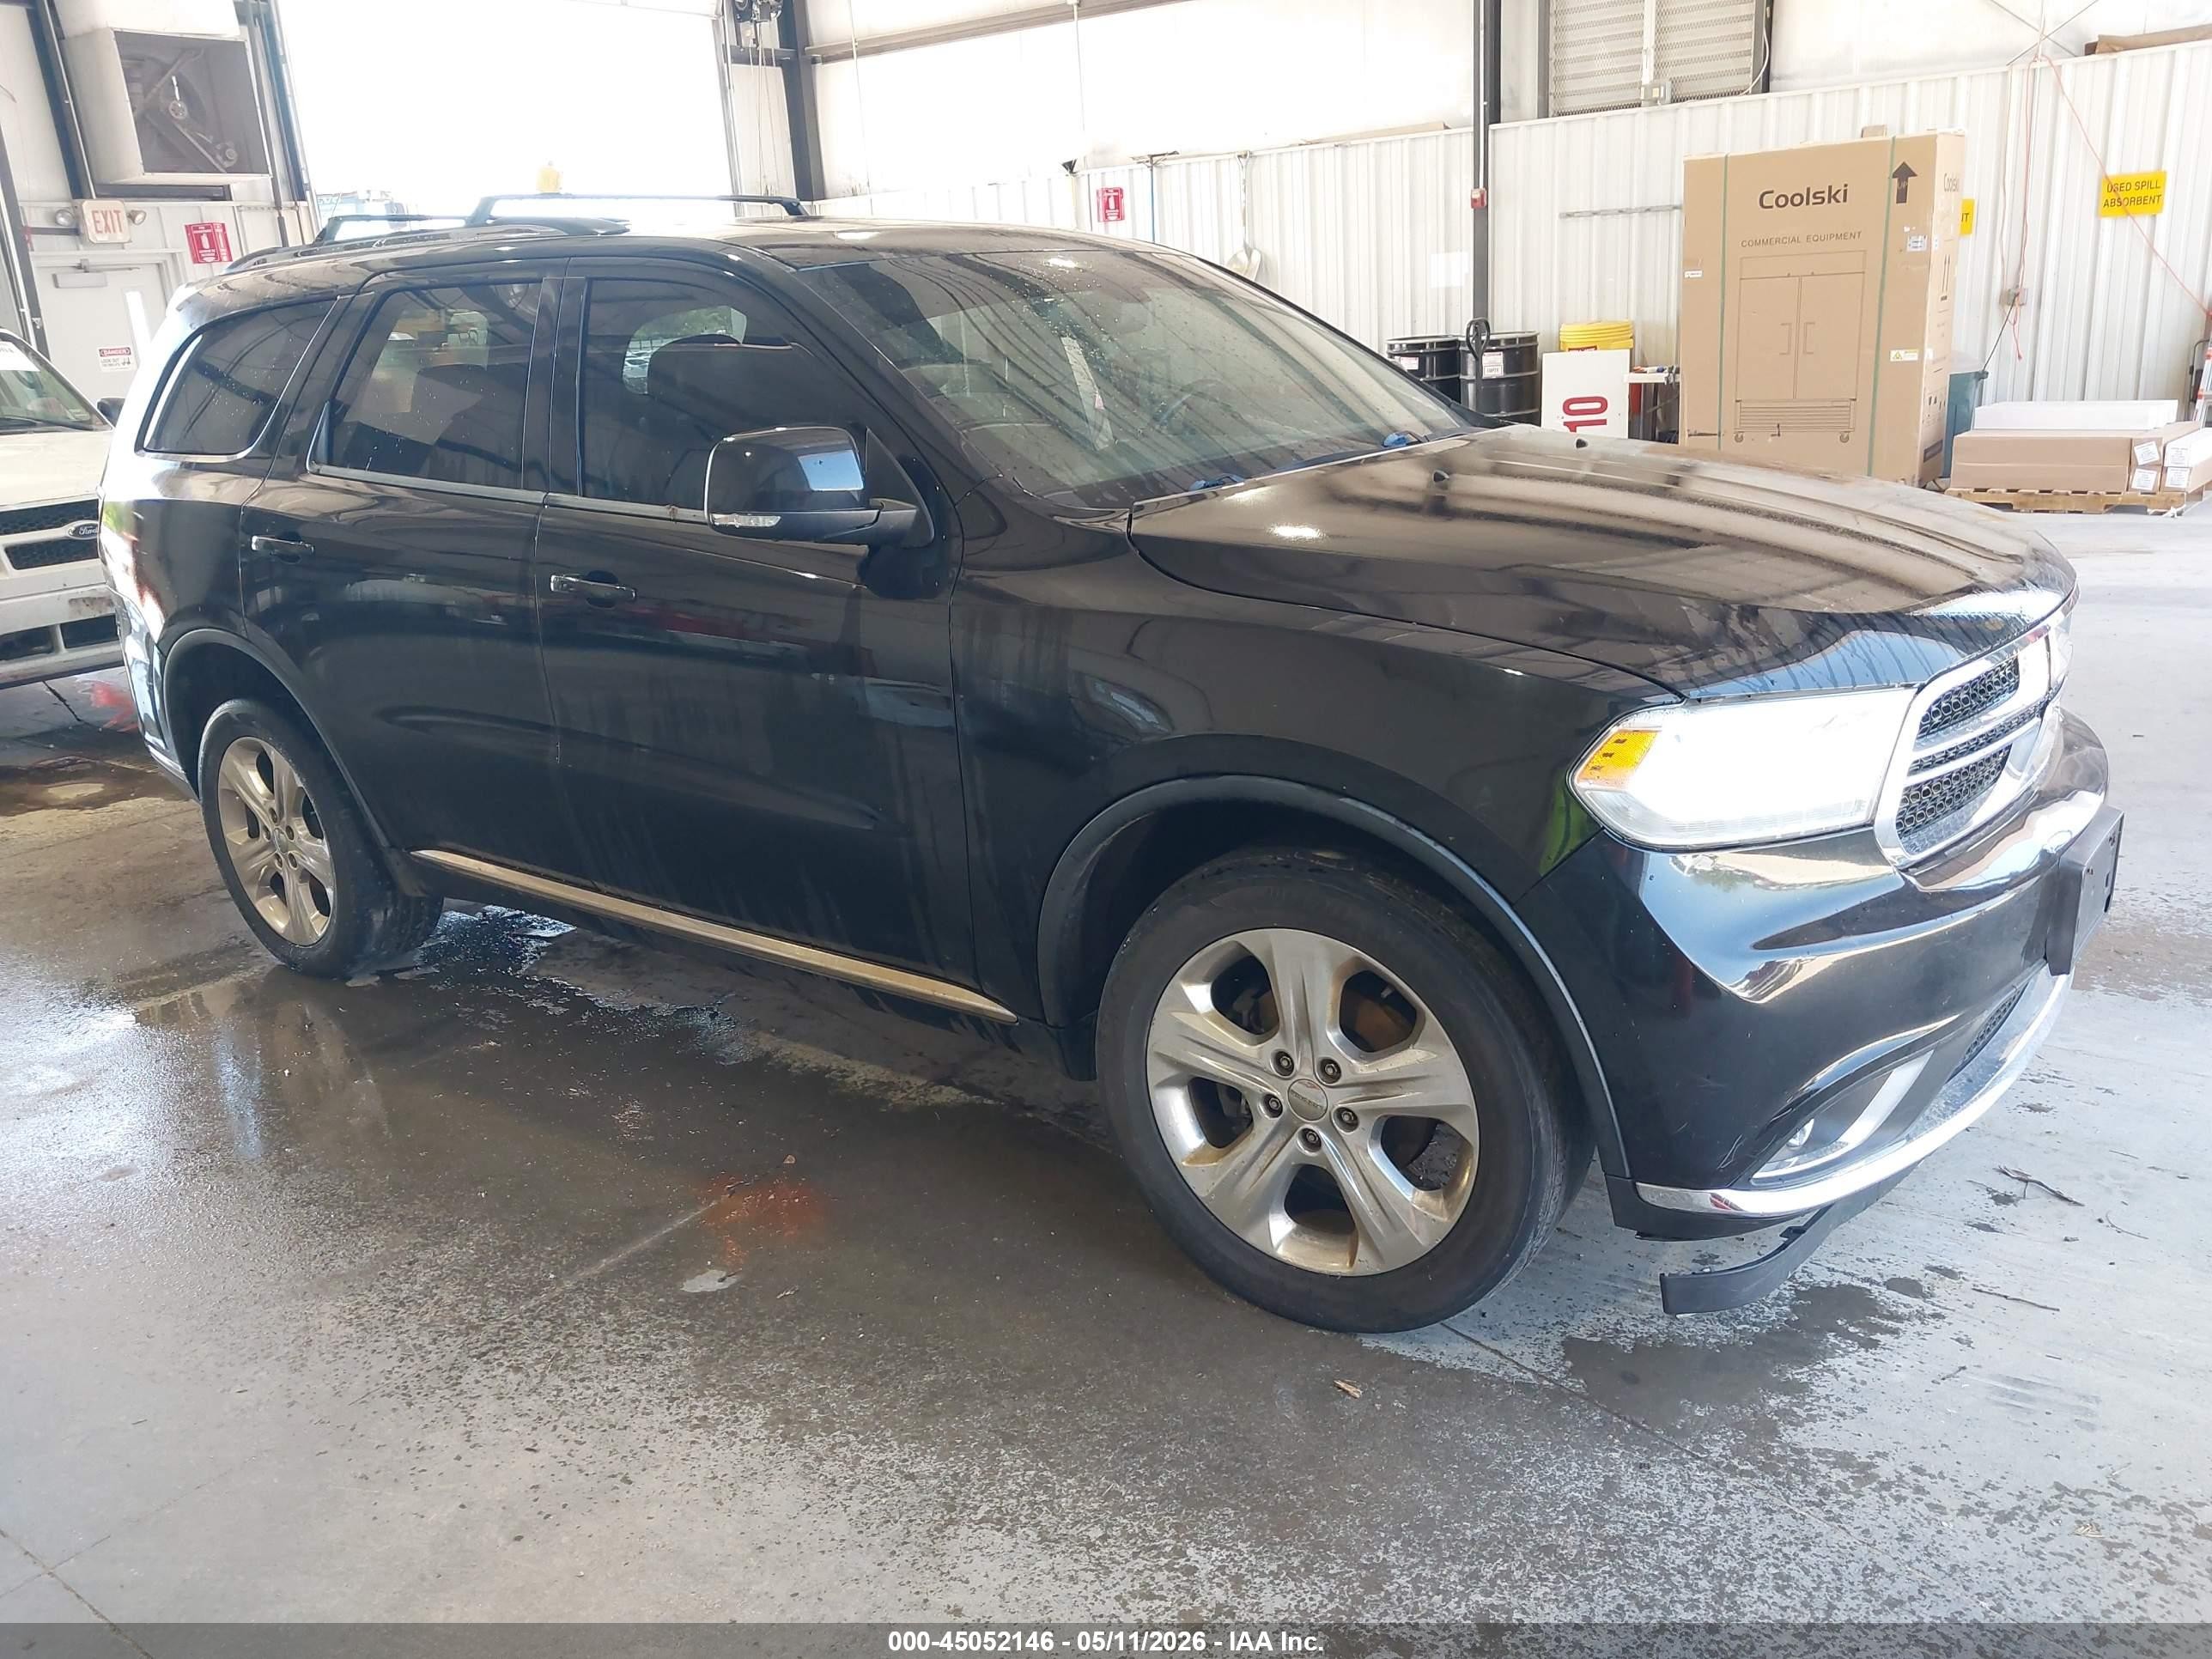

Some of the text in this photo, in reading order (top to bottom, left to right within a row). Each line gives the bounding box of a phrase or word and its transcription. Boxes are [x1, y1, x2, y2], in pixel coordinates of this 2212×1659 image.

[2106, 179, 2161, 193] USED SPILL
[1759, 183, 1849, 210] Coolski
[2102, 194, 2162, 209] ABSORBENT
[91, 210, 123, 234] EXIT
[1741, 231, 1863, 248] COMMERCIAL EQUIPMENT
[1563, 396, 1607, 433] 10
